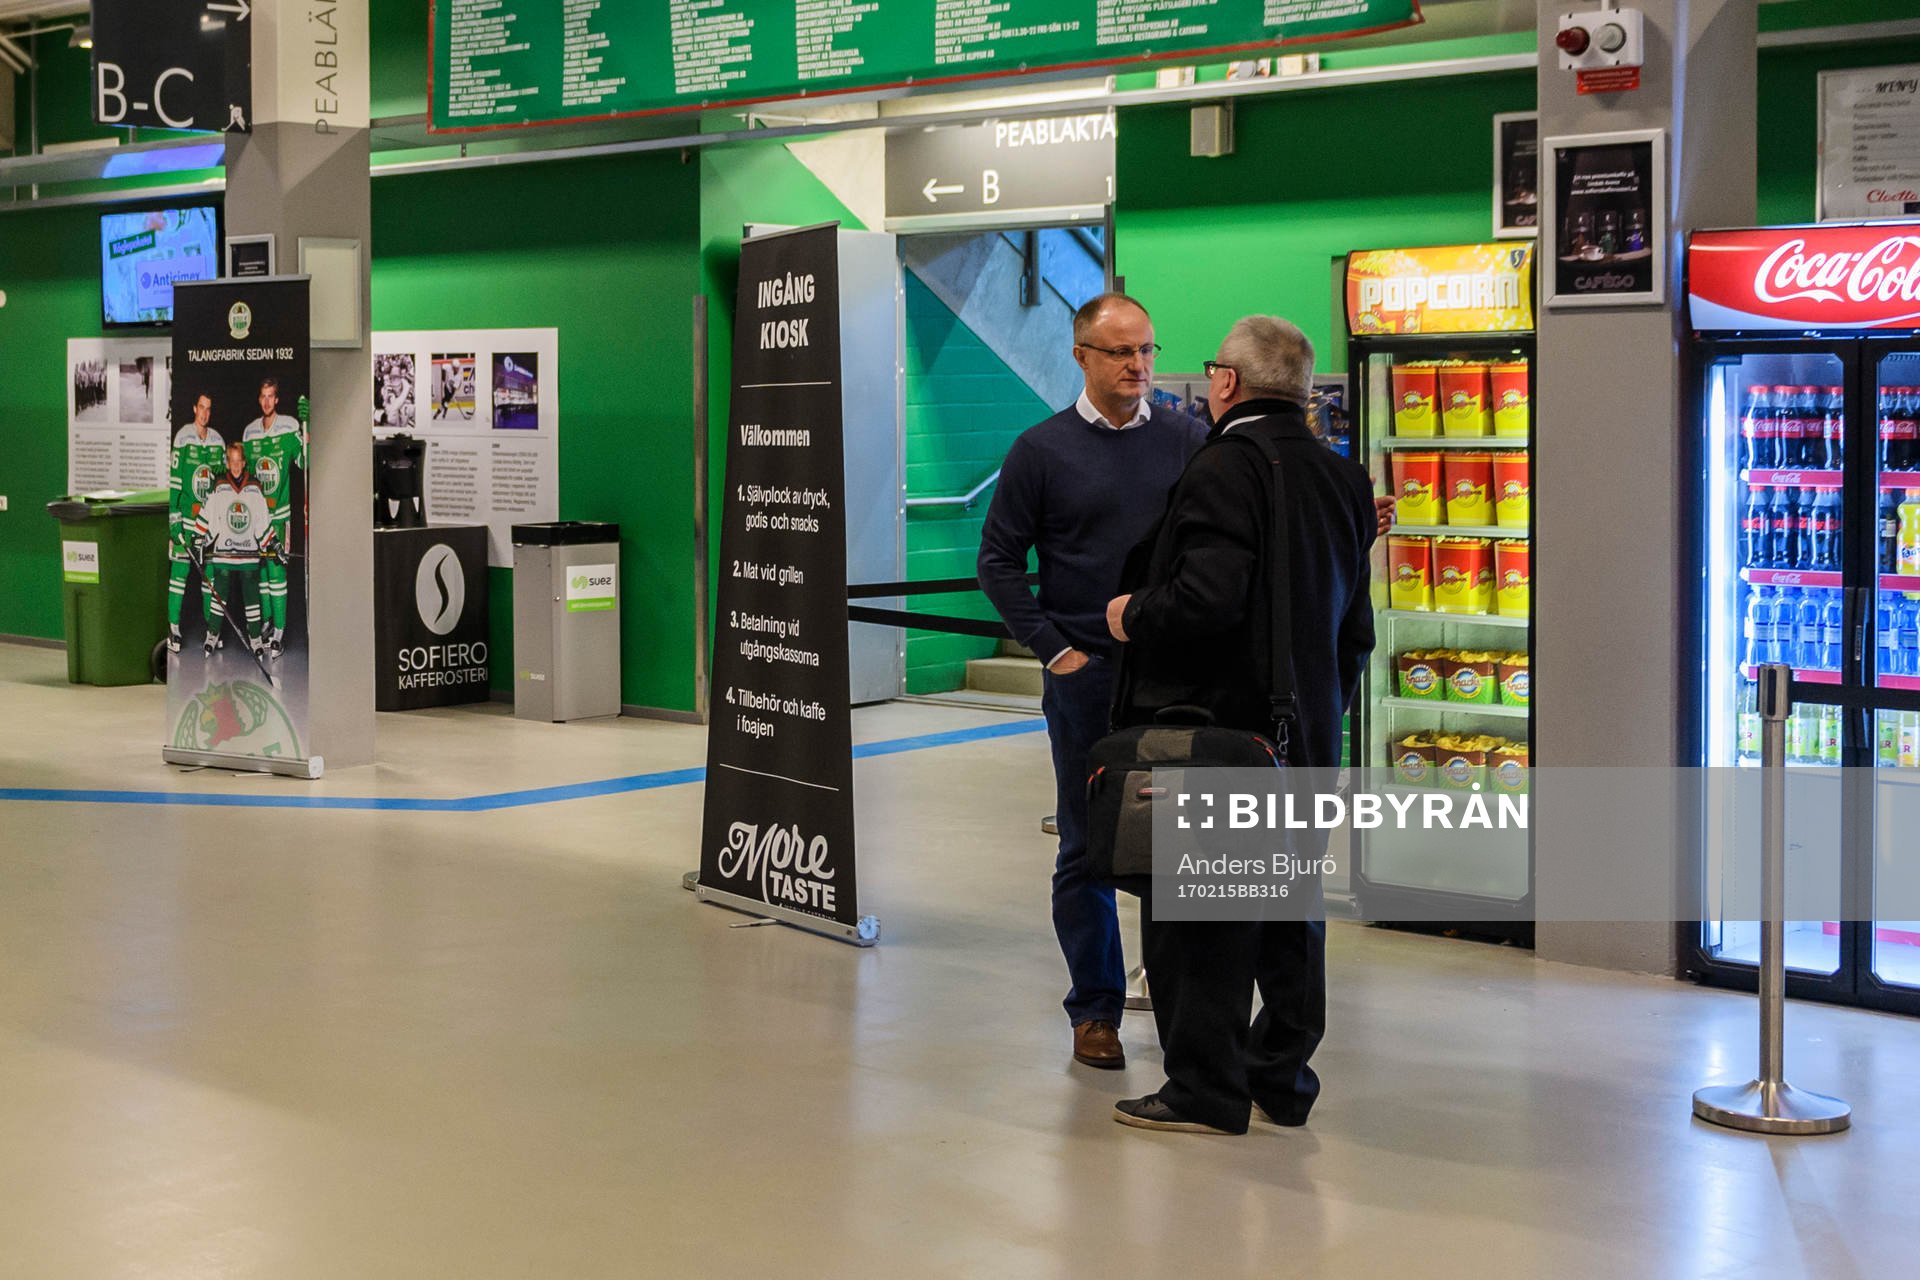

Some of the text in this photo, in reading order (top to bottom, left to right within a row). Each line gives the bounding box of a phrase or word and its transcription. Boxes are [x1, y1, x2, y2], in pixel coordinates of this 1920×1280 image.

[308, 0, 338, 135] PEABLÄ
[98, 61, 194, 128] B-C
[1875, 79, 1918, 94] MENY
[982, 169, 1000, 204] B
[1754, 235, 1920, 304] Coca-Col
[757, 271, 815, 309] INGÅNG
[1359, 272, 1520, 312] POPCORN
[760, 318, 809, 350] KIOSK
[188, 347, 294, 362] TALANGFABRIK SEDAN 1932
[740, 424, 810, 447] Välkommen
[737, 484, 831, 509] 1. Självplock av dryck,
[745, 512, 819, 533] godis och snacks
[588, 576, 612, 586] suez
[733, 560, 804, 586] 2. Mat vid grillen
[730, 610, 800, 638] 3. Betalning vid
[398, 641, 488, 672] SOFIERO
[740, 640, 820, 667] utgångskassorna
[398, 667, 488, 690] KAFFEROSTERI
[725, 686, 826, 721] 4. Tillbehör och kaffe
[736, 713, 774, 740] i foajen
[718, 821, 835, 905] More
[769, 870, 836, 912] TASTE
